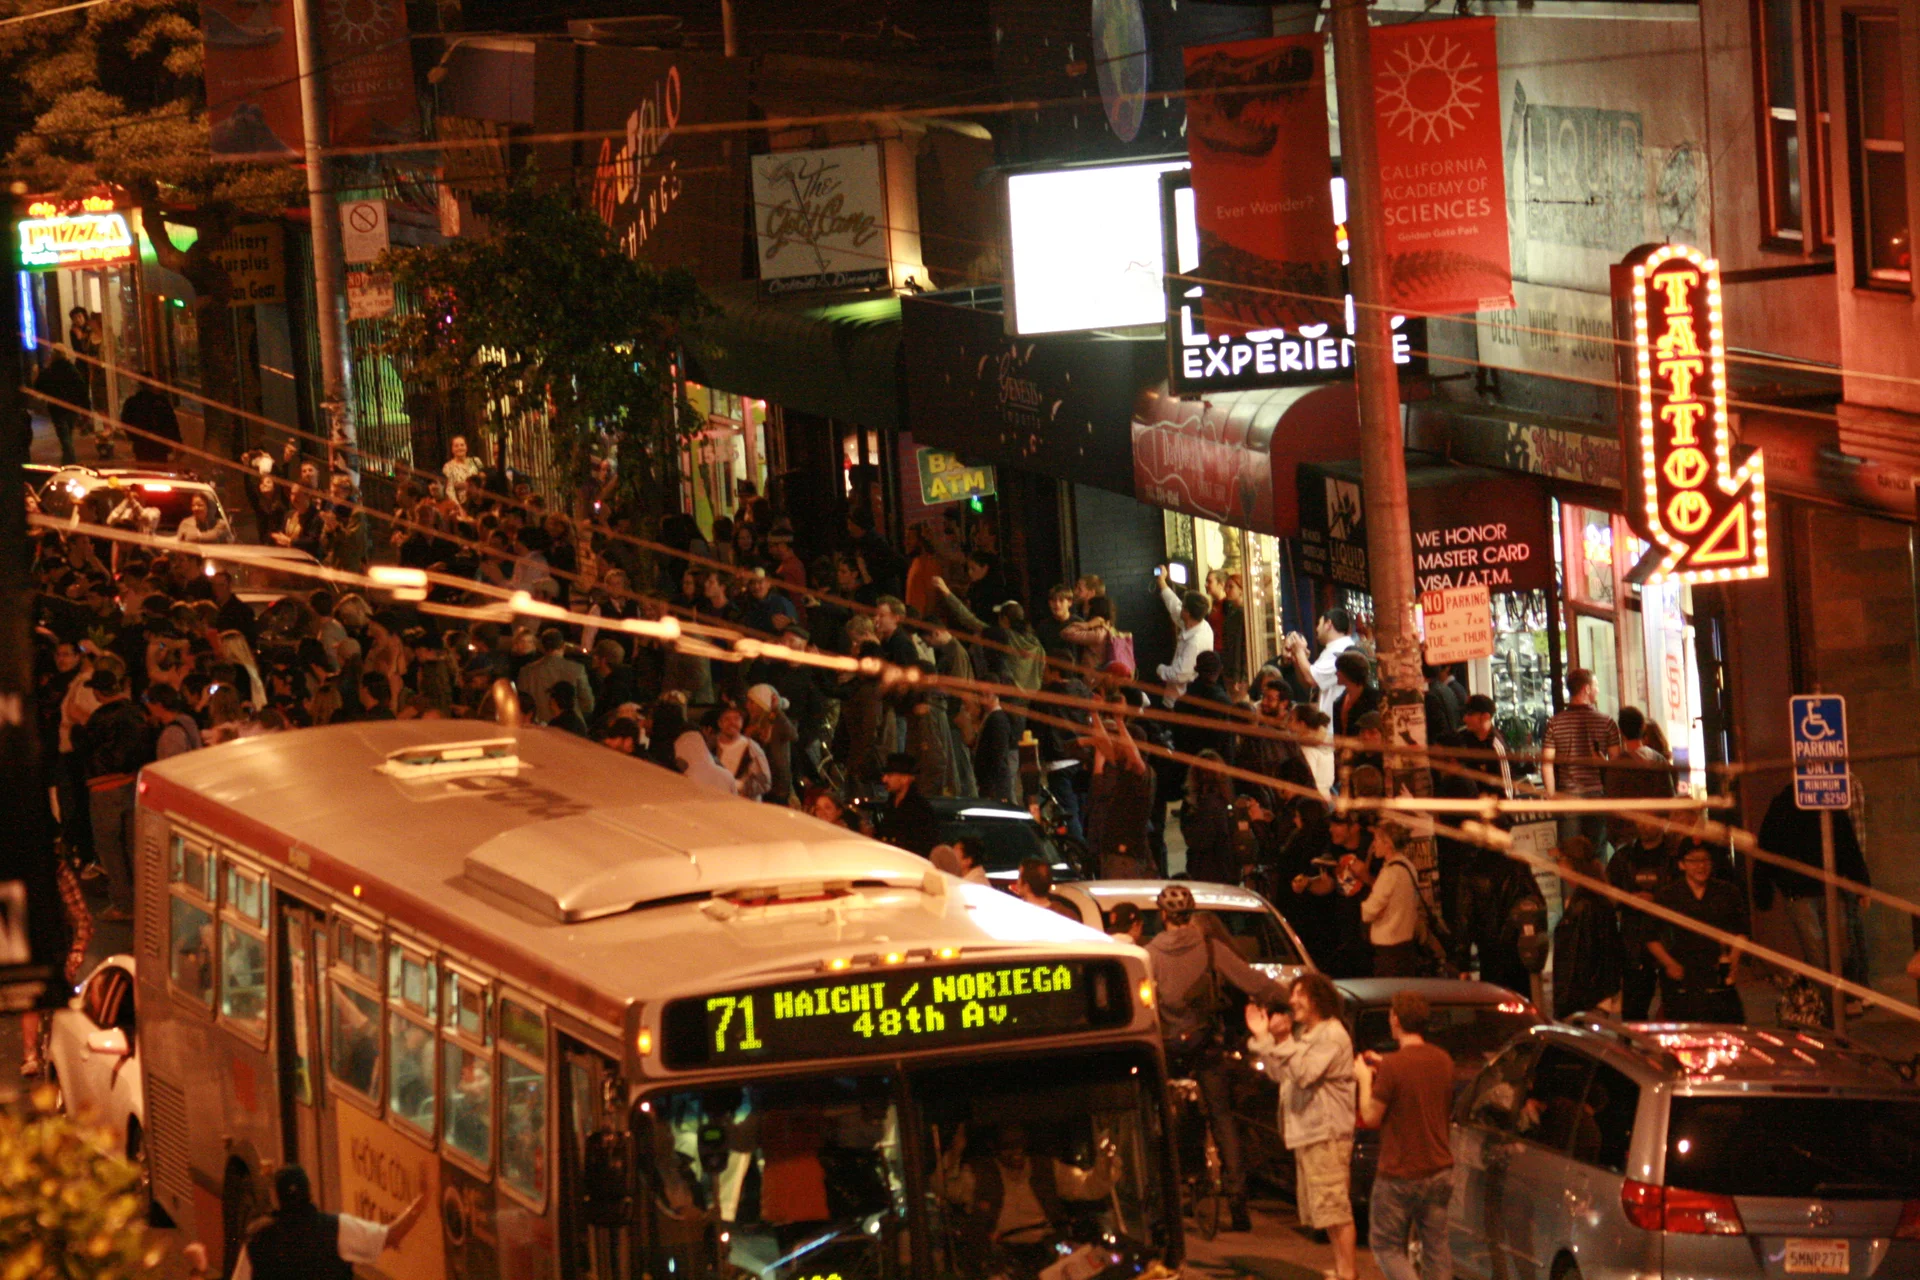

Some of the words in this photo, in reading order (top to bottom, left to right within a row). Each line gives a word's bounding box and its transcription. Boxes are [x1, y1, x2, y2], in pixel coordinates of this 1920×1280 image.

[333, 80, 404, 96] SCIENCES
[1380, 157, 1488, 182] CALIFORNIA
[1383, 179, 1466, 202] ACADEMY
[1467, 177, 1489, 194] OF
[1216, 205, 1245, 221] Ever
[1248, 196, 1314, 215] Wonder?
[1383, 197, 1491, 227] SCIENCES
[24, 217, 129, 250] PIZZA
[1397, 230, 1433, 242] Golden
[1433, 226, 1457, 238] Gate
[1457, 224, 1480, 235] Park
[1490, 308, 1519, 346] BEER
[1528, 309, 1559, 353] WINE
[1653, 271, 1712, 533] TATTOO
[930, 470, 986, 498] ATM
[1416, 530, 1440, 548] WE
[1445, 523, 1507, 545] HONOR
[1418, 548, 1479, 570] MASTER
[1483, 543, 1530, 564] CARD
[1418, 573, 1453, 591] VISA
[1423, 594, 1442, 612] NO
[1445, 592, 1486, 609] PARKING
[1796, 741, 1844, 757] PARKING
[1805, 761, 1834, 774] ONLY
[1799, 792, 1817, 804] FINE
[1822, 792, 1847, 804] $250
[1803, 780, 1840, 791] MINIMUM
[707, 995, 762, 1052] 71
[774, 982, 885, 1020] HAIGHT
[933, 965, 1072, 1003] NORIEGA
[852, 1003, 945, 1038] 48th
[962, 1000, 1018, 1028] Av.
